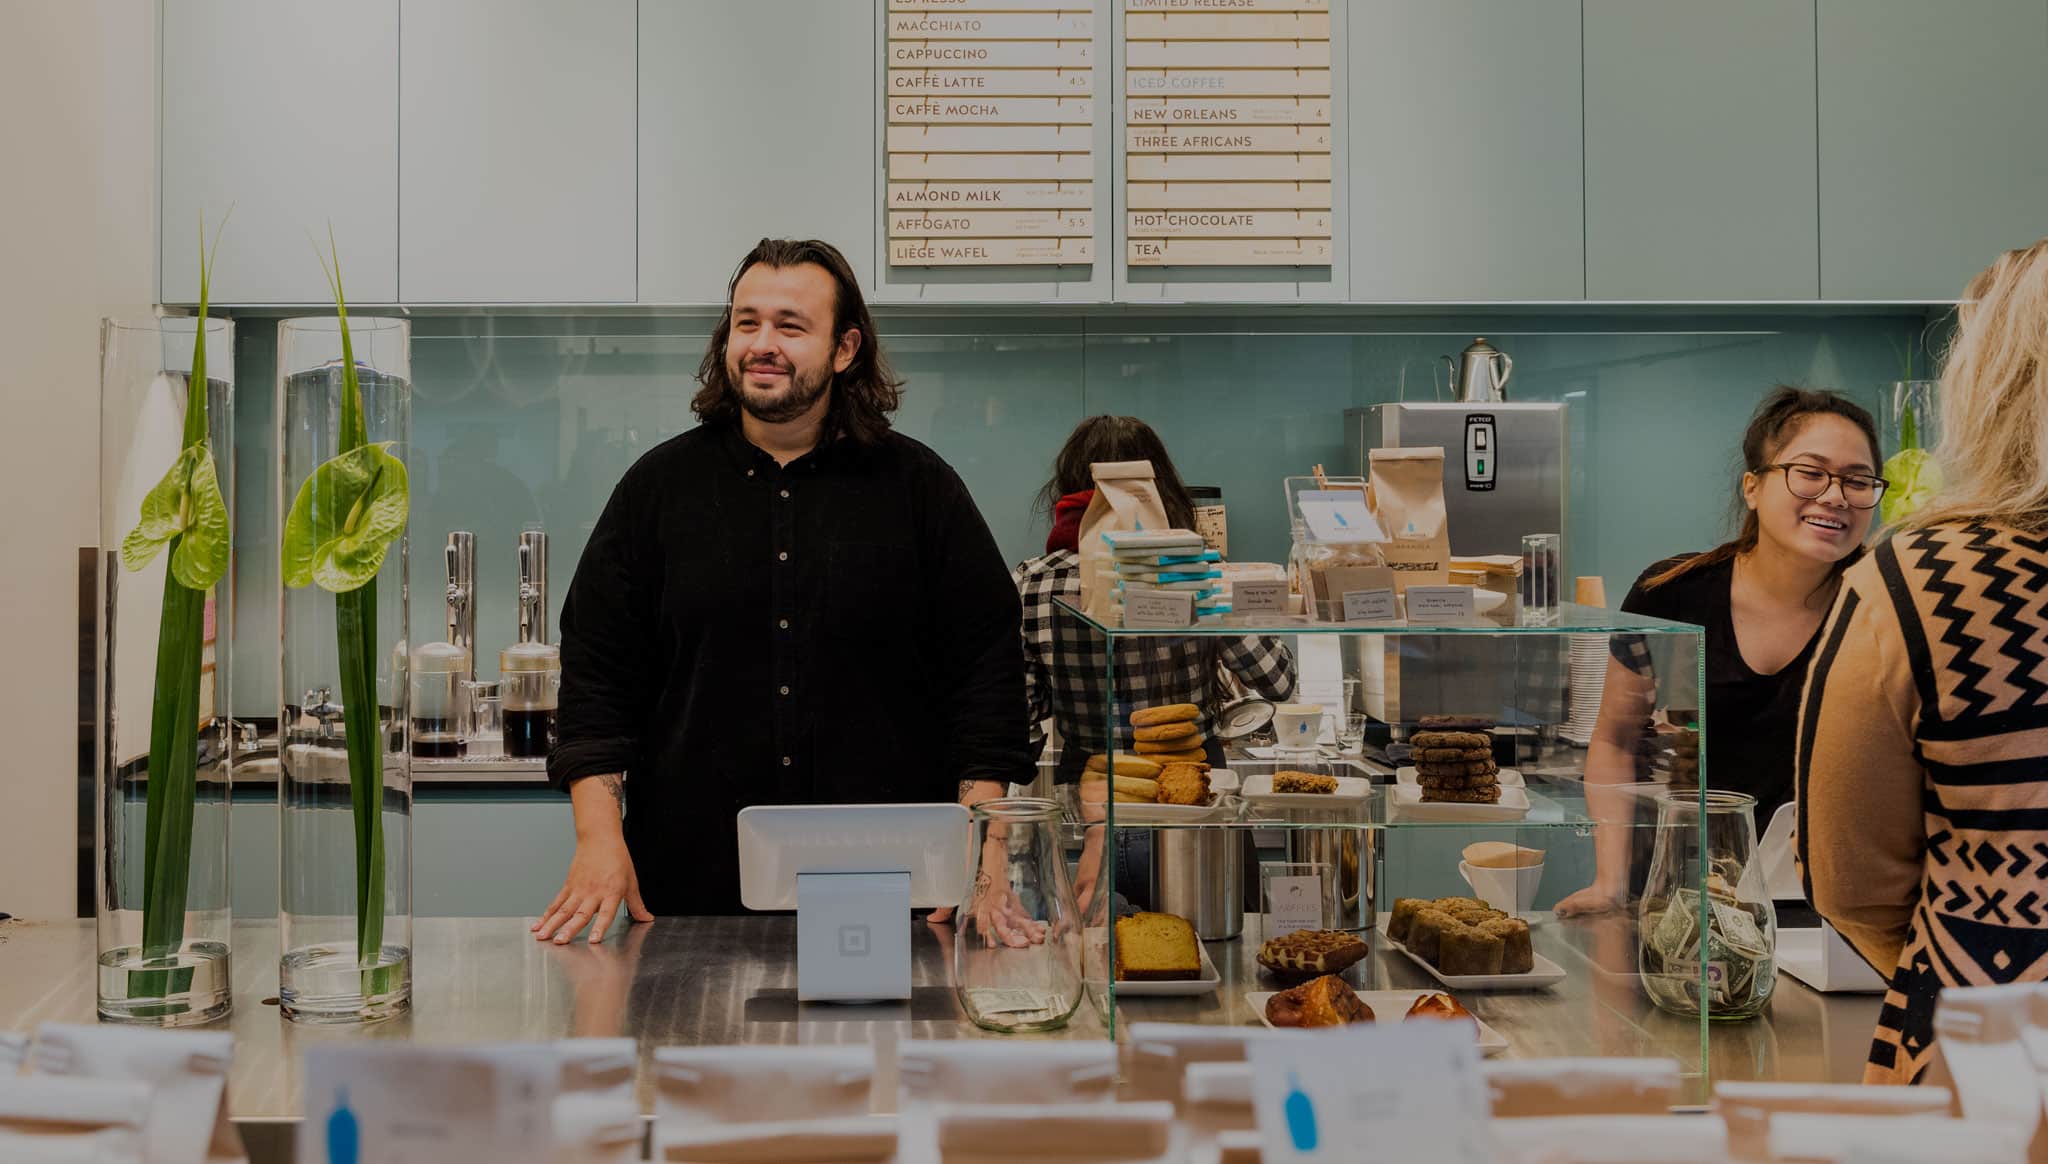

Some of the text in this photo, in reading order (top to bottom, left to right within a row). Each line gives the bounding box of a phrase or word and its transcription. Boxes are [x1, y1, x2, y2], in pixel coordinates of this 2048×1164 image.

[1133, 0, 1254, 8] LIMITED RELEASE
[896, 20, 982, 32] MACCHIATO
[896, 48, 1087, 60] CAPPUCCINO 4
[944, 77, 985, 88] LATTE
[1133, 77, 1225, 89] ICED COFFEE
[945, 104, 999, 116] MOCHA
[1133, 108, 1167, 121] NEW
[1172, 108, 1238, 121] ORLEANS
[1133, 135, 1324, 148] THREE AFRICANS 4
[896, 190, 1001, 202] ALMOND MILK
[896, 219, 971, 231] AFFOGATO
[1134, 215, 1163, 226] HOT
[1168, 215, 1254, 226] CHOCOLATE
[941, 247, 989, 259] WAFEL
[1134, 243, 1162, 256] TEA
